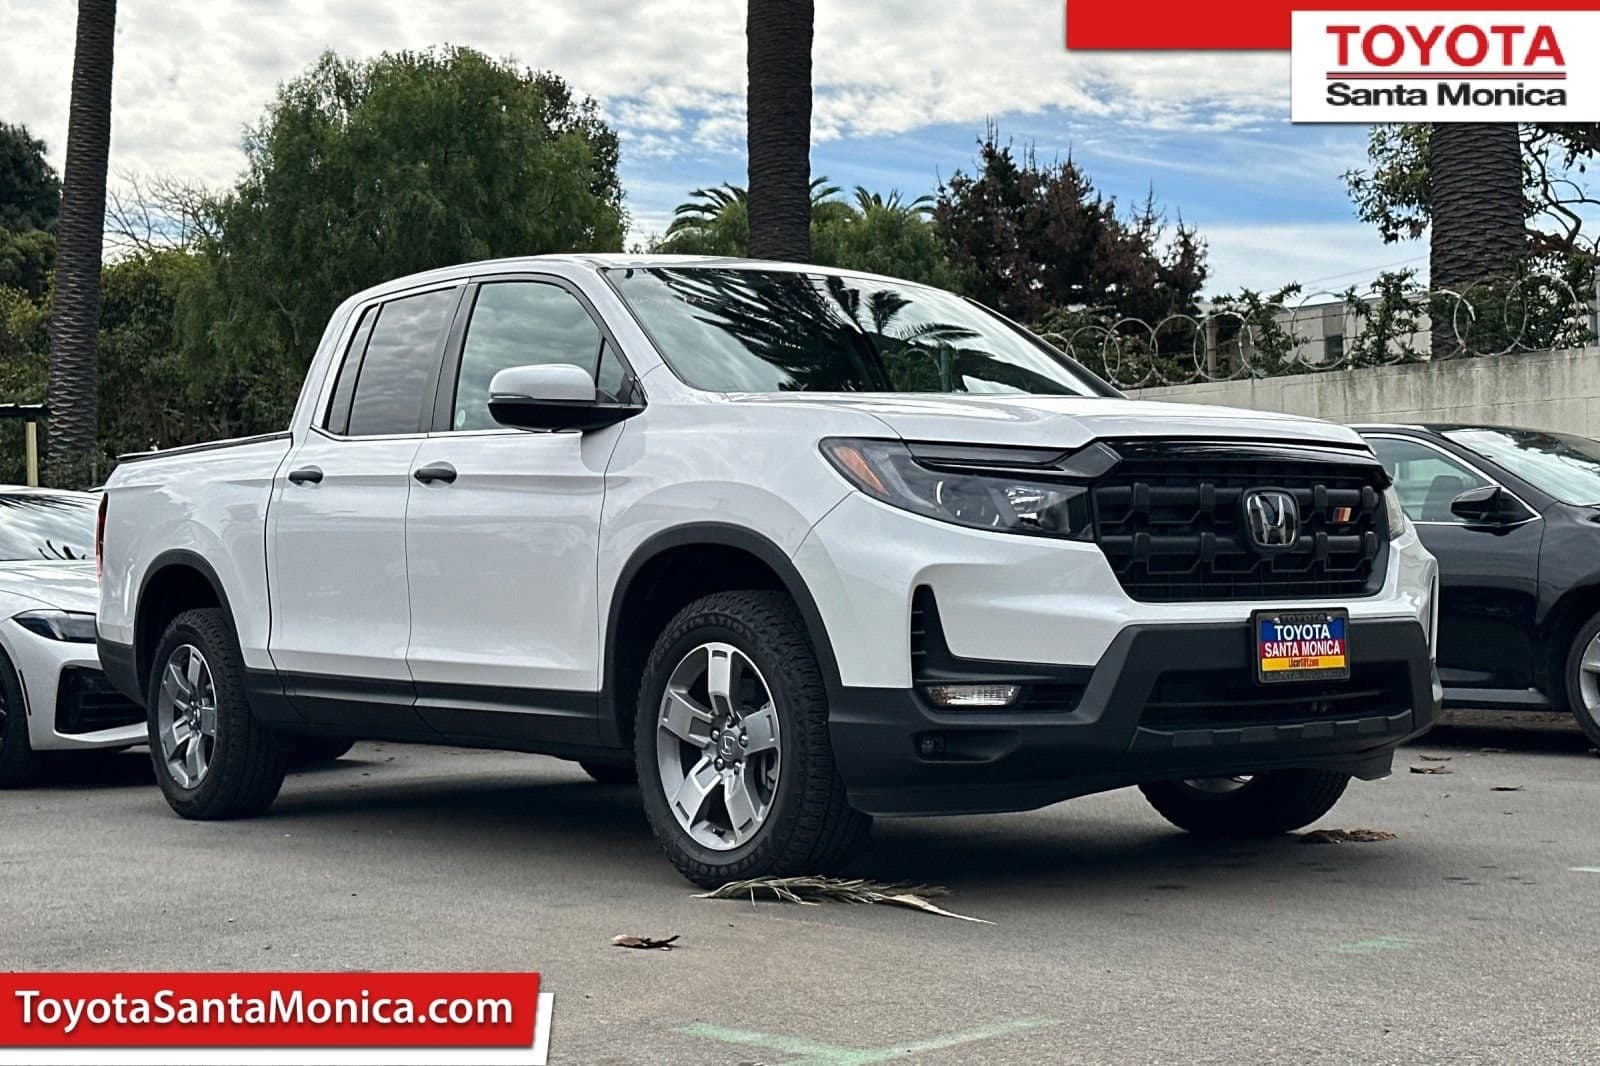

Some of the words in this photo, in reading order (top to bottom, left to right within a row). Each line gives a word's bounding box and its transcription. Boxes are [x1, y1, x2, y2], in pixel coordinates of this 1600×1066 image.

[1274, 624, 1331, 640] TOYOTA
[1265, 641, 1300, 657] SANTA
[1301, 640, 1341, 656] MONICA
